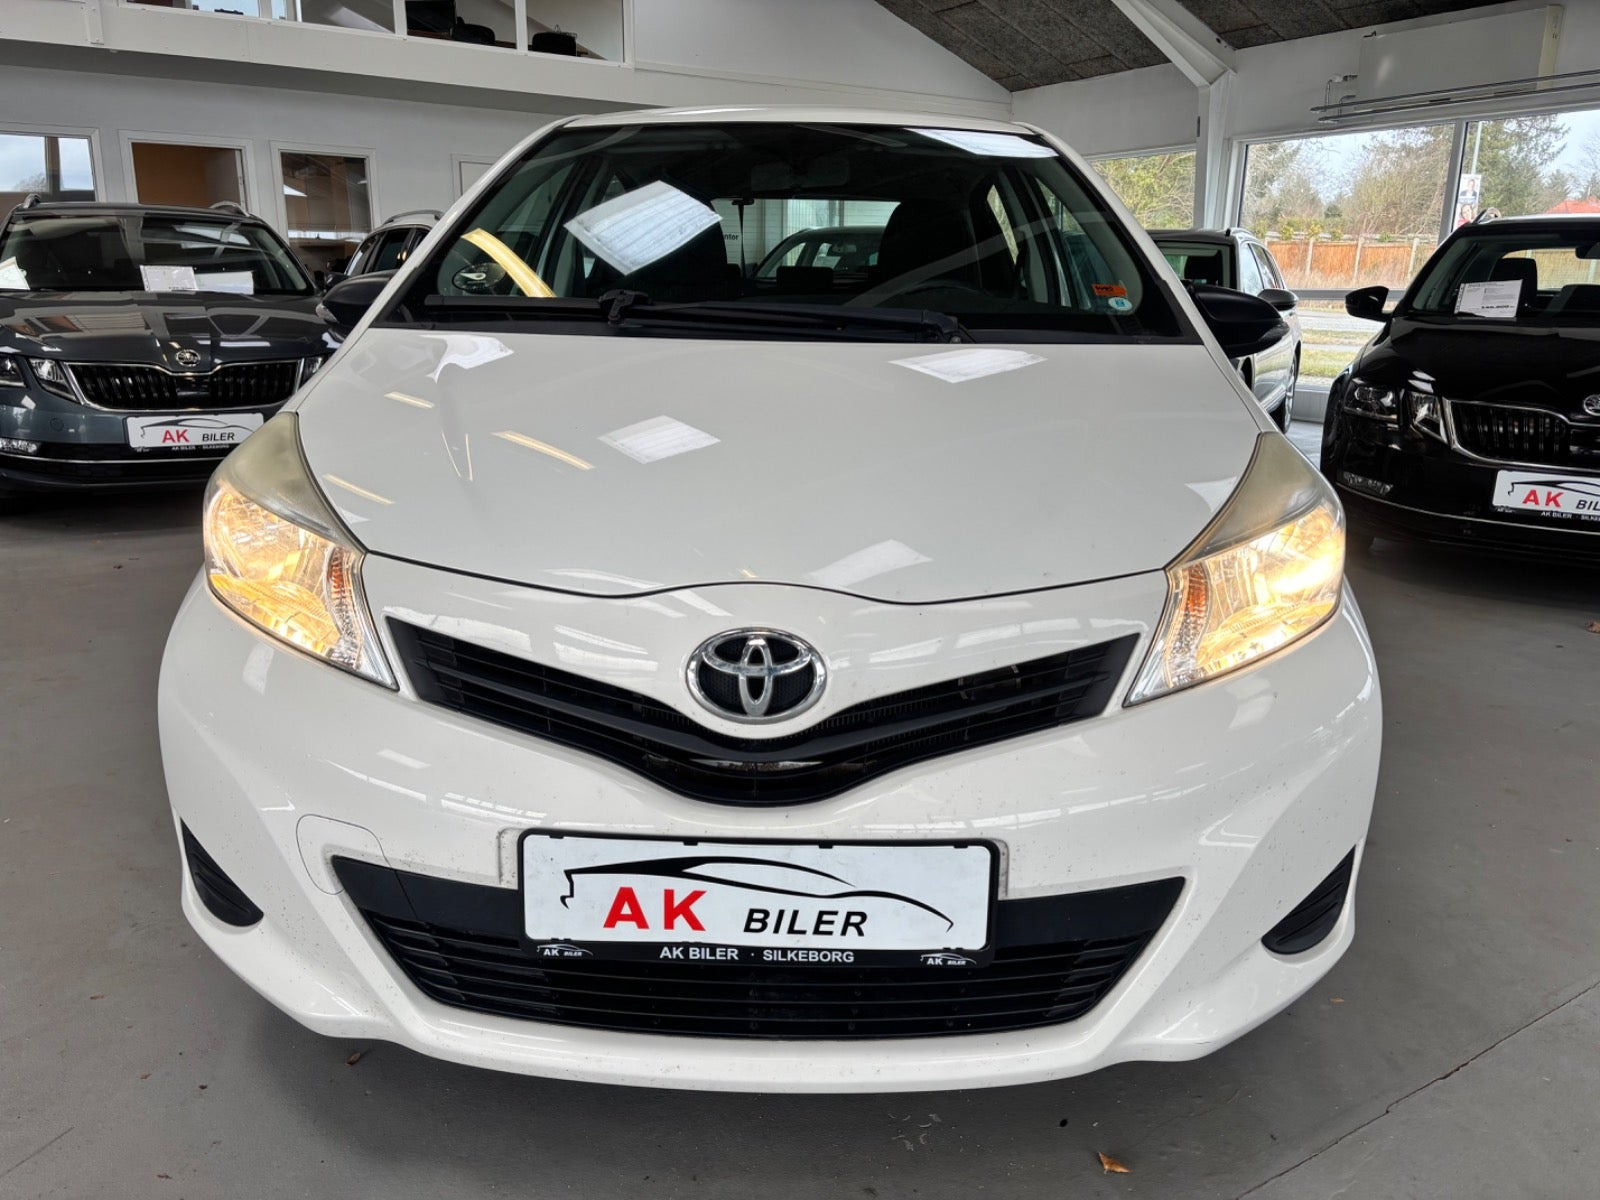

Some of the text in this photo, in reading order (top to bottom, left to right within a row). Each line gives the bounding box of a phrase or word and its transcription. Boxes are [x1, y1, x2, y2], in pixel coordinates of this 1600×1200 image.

[162, 429, 235, 443] AK BILER
[1522, 489, 1563, 508] AK
[603, 886, 867, 937] AK BILER
[543, 948, 560, 956] AK
[659, 946, 855, 963] AK BILER SILKEBORG
[926, 957, 943, 966] AK
